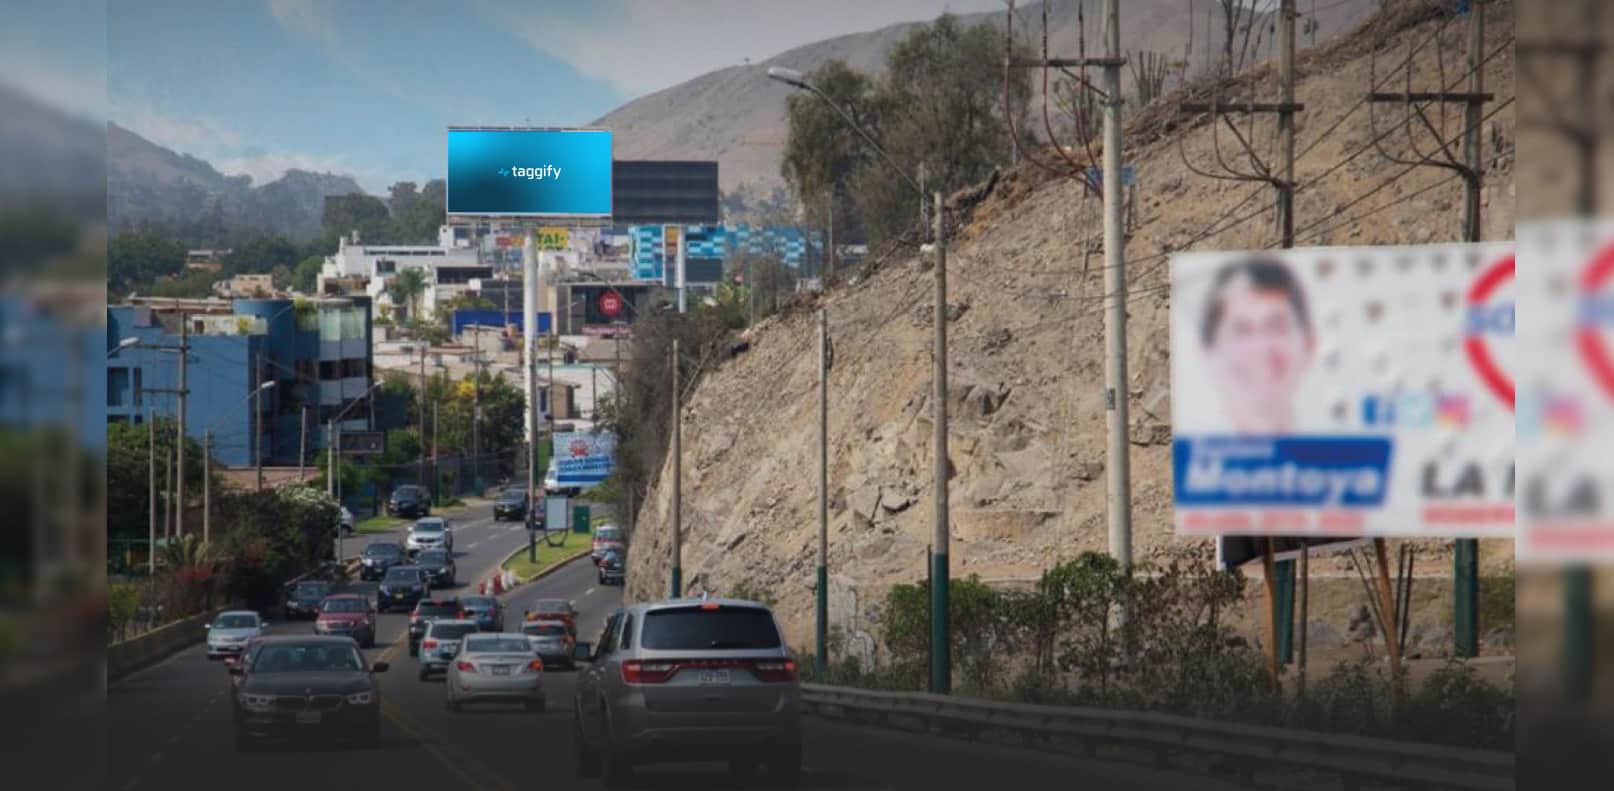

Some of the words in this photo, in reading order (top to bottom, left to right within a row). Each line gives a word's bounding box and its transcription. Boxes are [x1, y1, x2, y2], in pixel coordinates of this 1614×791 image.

[511, 164, 562, 180] taggify
[1186, 454, 1380, 506] Montoya
[1420, 459, 1485, 498] LA
